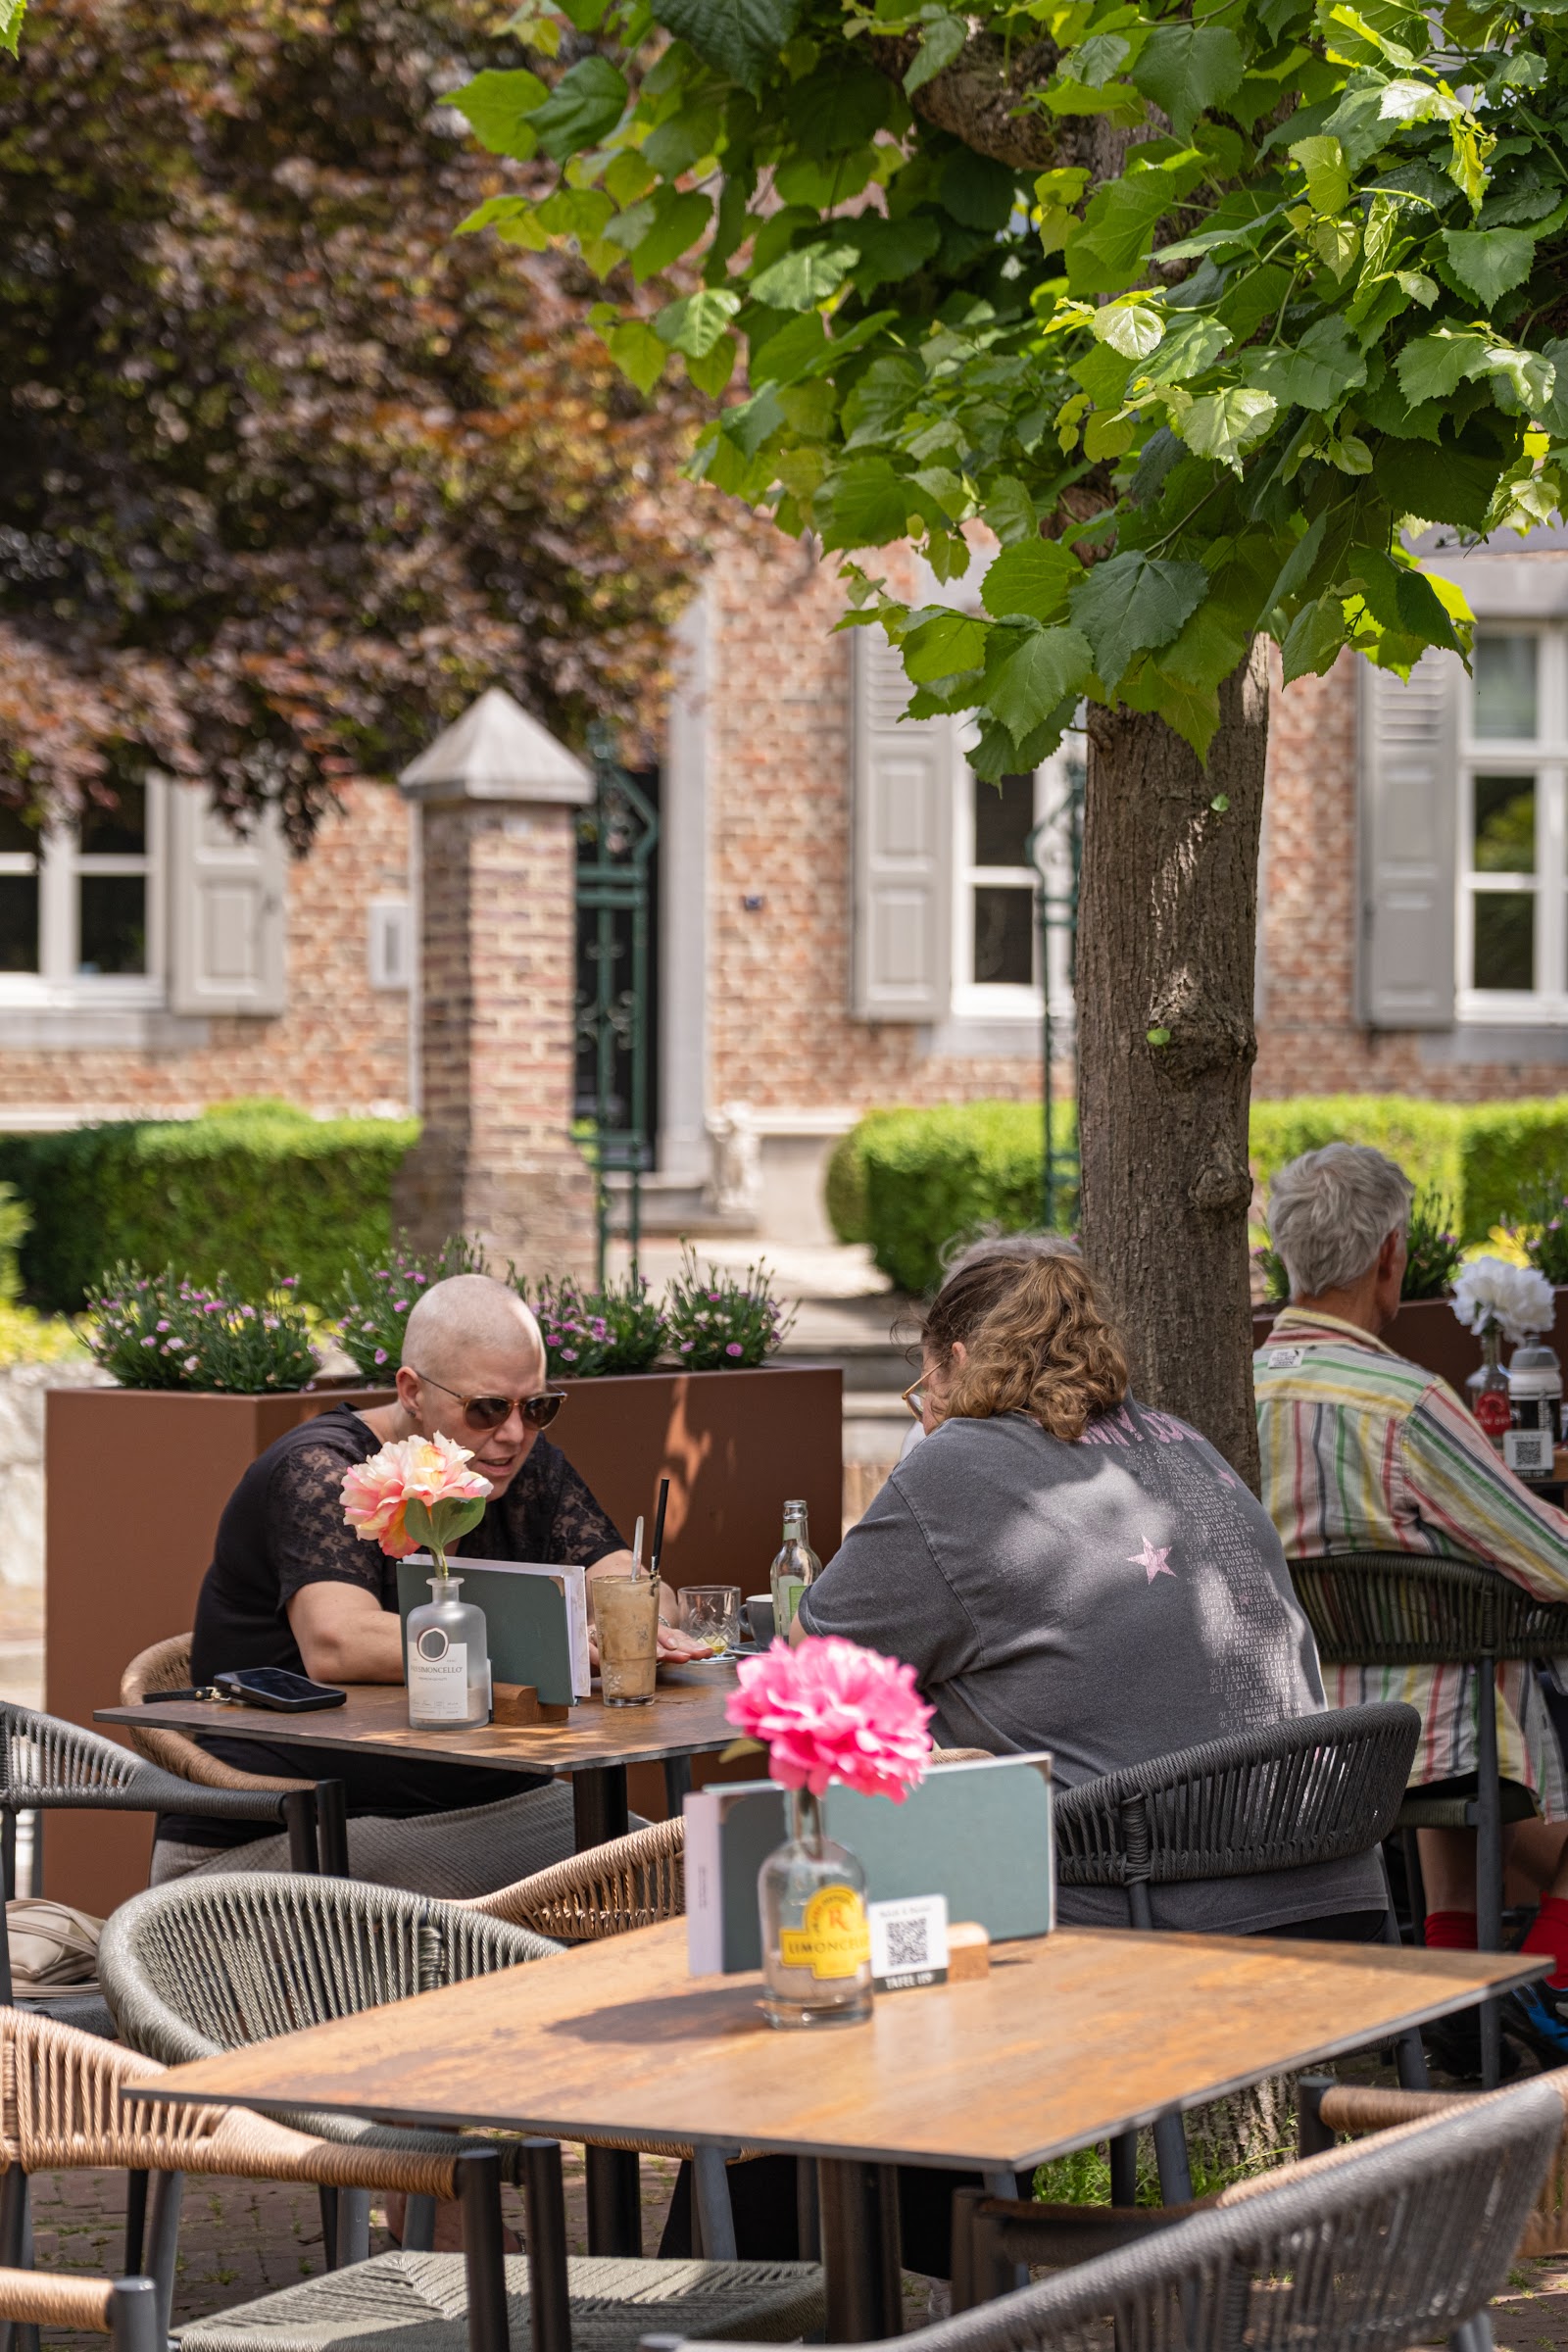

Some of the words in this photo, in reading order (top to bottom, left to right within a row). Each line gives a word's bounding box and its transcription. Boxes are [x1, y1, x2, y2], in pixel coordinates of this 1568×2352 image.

[1171, 1490, 1217, 1498] PHILADELPHI
[1193, 1509, 1225, 1518] RALEIGH
[1194, 1515, 1235, 1525] NASHVILLE
[1201, 1521, 1236, 1531] ATLANTA
[1201, 1527, 1245, 1539] LOUISVILLE
[1213, 1535, 1241, 1544] TAMPA
[1217, 1544, 1243, 1552] MIAMI
[1215, 1549, 1251, 1560] ORLANDO
[1218, 1558, 1253, 1567] HOUSTON
[1227, 1565, 1252, 1575] AUSTIN
[1218, 1574, 1239, 1583] FORT
[1229, 1580, 1260, 1590] DENVER
[1228, 1588, 1266, 1598] GLENDALE
[1245, 1594, 1268, 1604] EGAS
[1201, 1607, 1219, 1616] SEPT
[1231, 1605, 1247, 1614] SAN
[1249, 1603, 1272, 1612] DIEGO
[1236, 1612, 1272, 1622] ANAHEIM
[1247, 1619, 1280, 1629] ANGELES
[1241, 1627, 1283, 1639] FRANCISCO
[1211, 1641, 1227, 1649] OCT
[1235, 1637, 1274, 1647] PORTLAND
[1233, 1644, 1280, 1656] VANCOUVER
[1241, 1654, 1272, 1664] SEATTLE
[1231, 1665, 1249, 1674] SALT
[1250, 1662, 1268, 1672] LAKE
[1270, 1660, 1286, 1669] CITY
[1209, 1677, 1223, 1686] OCT
[1232, 1674, 1250, 1683] SALT
[1251, 1670, 1270, 1680] LAKE
[1271, 1668, 1288, 1678] CITY
[1209, 1686, 1223, 1694] OCT
[1236, 1682, 1252, 1690] SALT
[1254, 1679, 1272, 1688] LAKE
[1274, 1677, 1290, 1686] CITY
[1250, 1688, 1280, 1697] BELFAST
[1254, 1695, 1280, 1706] DUBLIN
[1219, 1711, 1233, 1721] OCT
[1244, 1702, 1291, 1715] MANCHESTER
[1220, 1720, 1234, 1729] OCT
[1245, 1711, 1292, 1725] MANCHESTER
